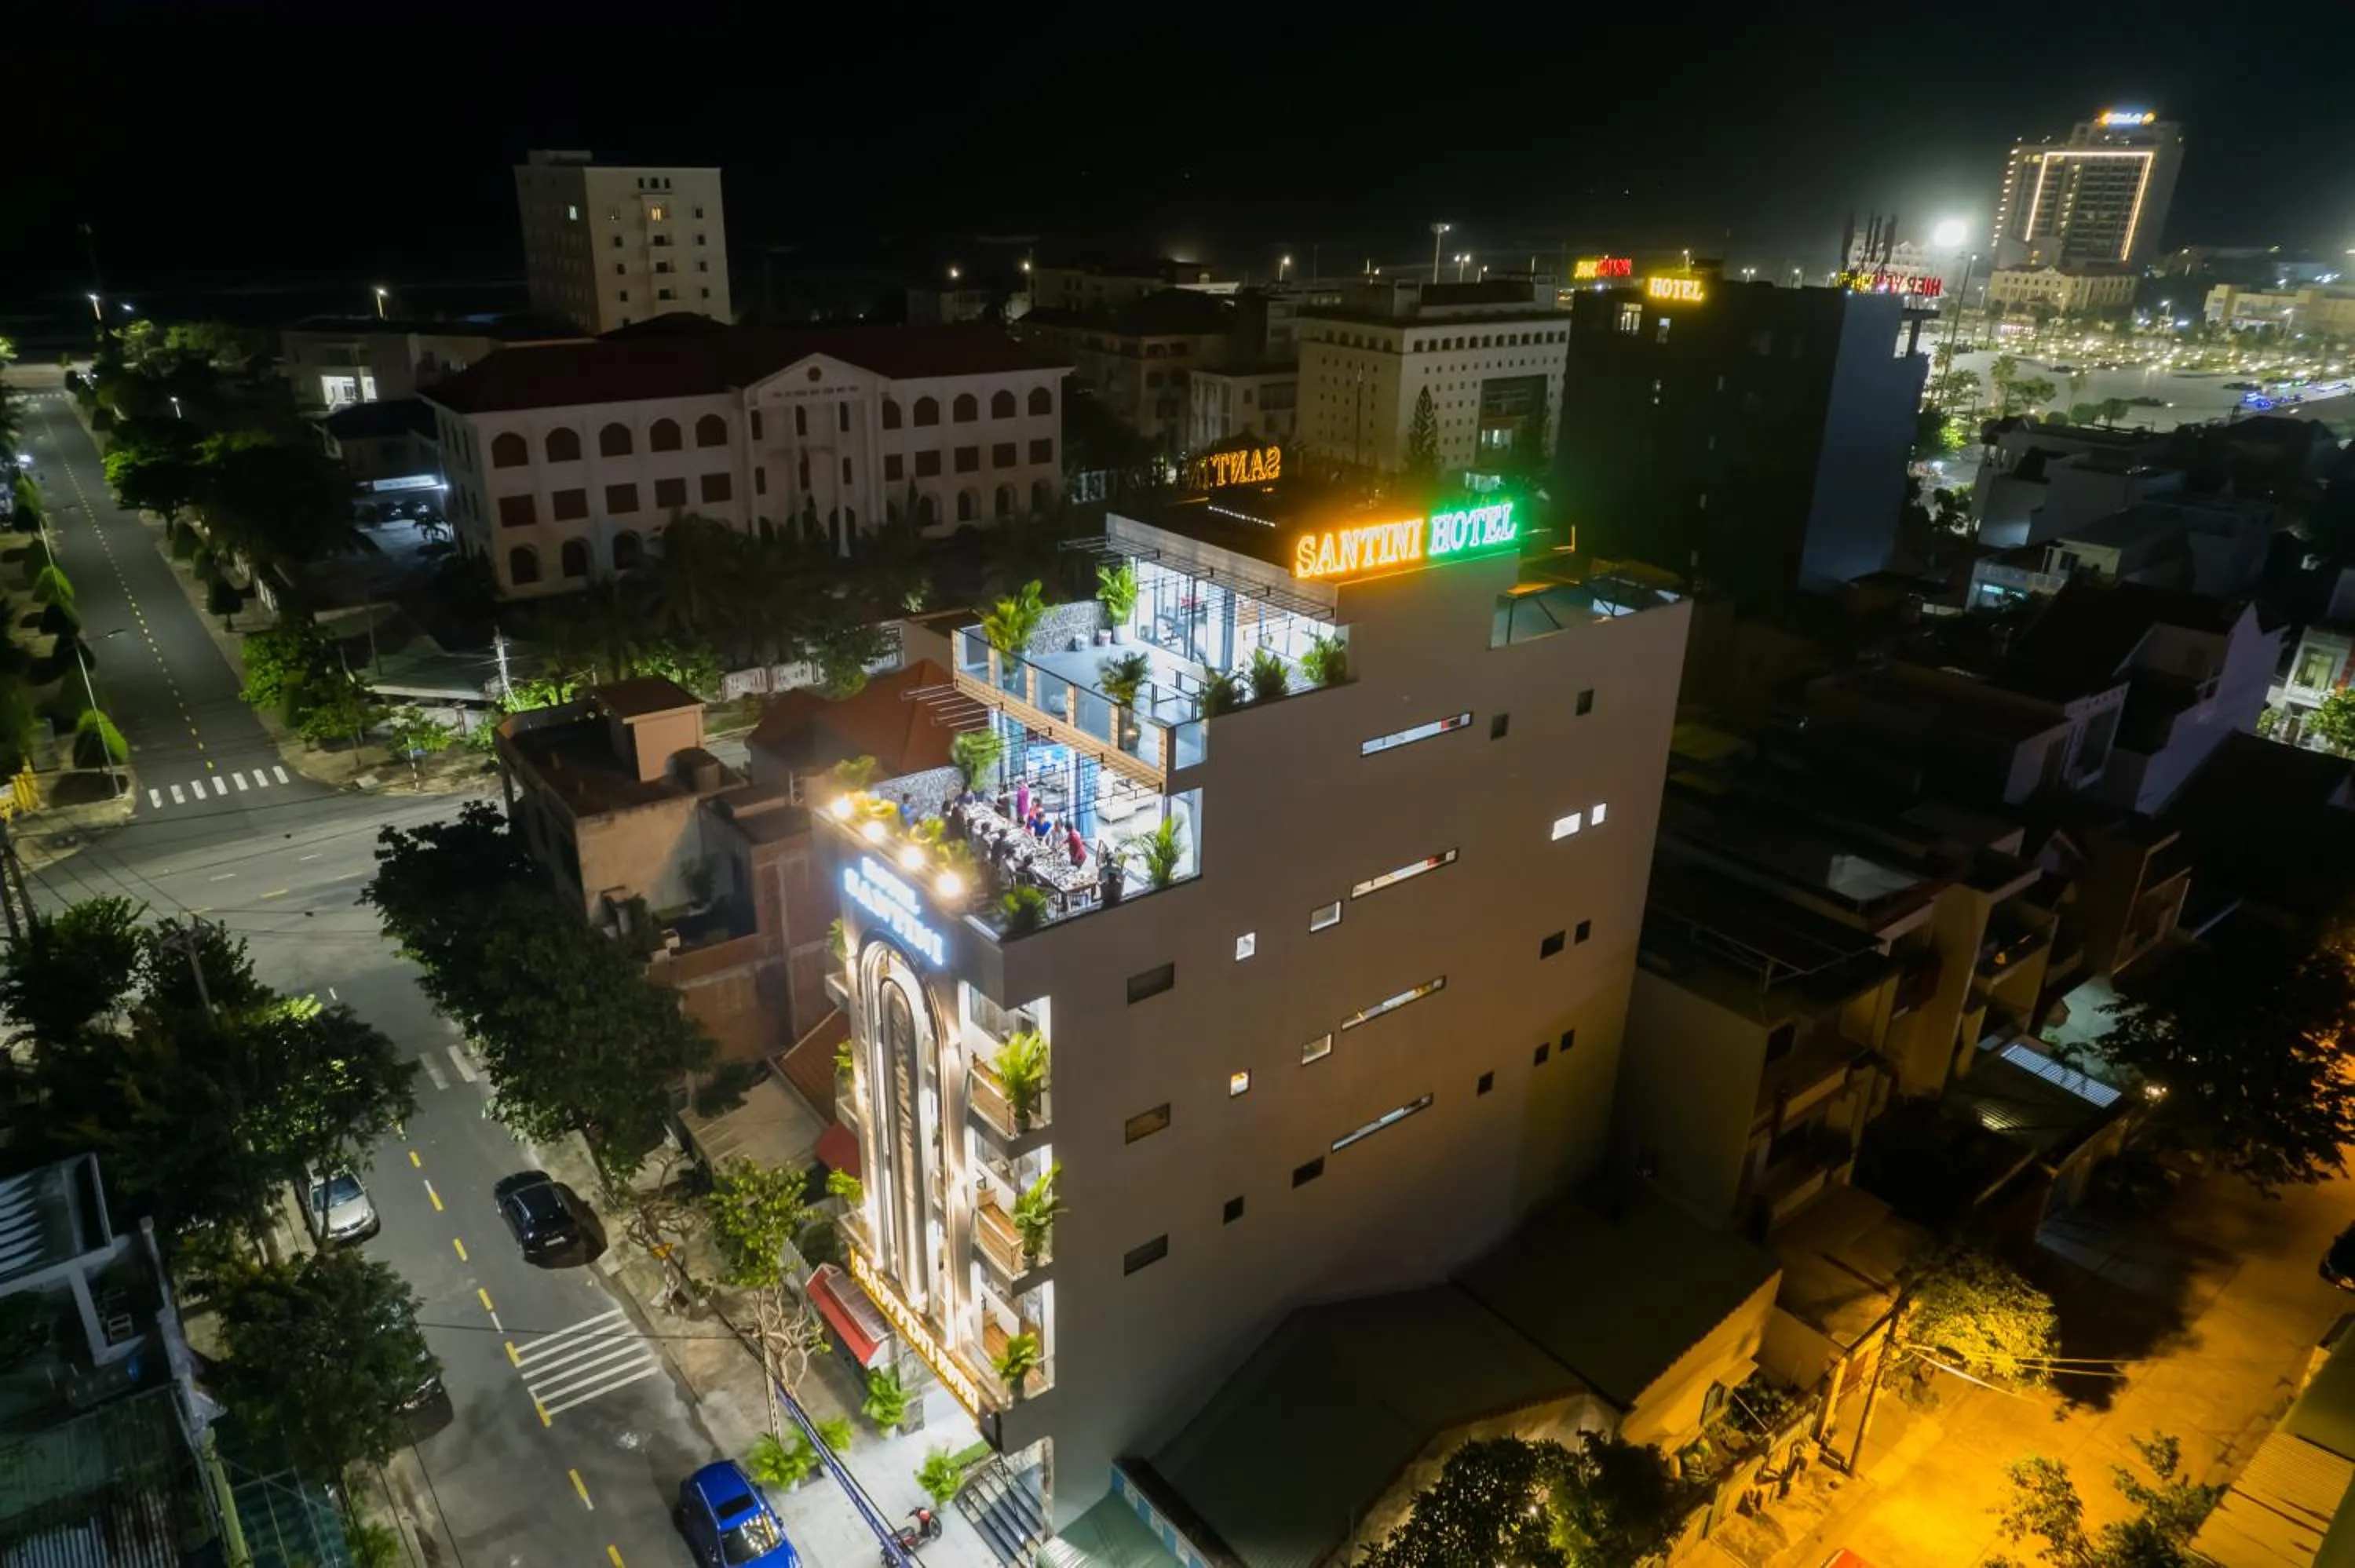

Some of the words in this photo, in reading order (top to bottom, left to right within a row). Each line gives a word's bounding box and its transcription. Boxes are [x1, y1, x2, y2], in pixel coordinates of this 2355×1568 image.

[1649, 276, 1704, 301] HOTEL
[1294, 517, 1425, 578] SANTINI
[1428, 501, 1517, 556] HOTEL
